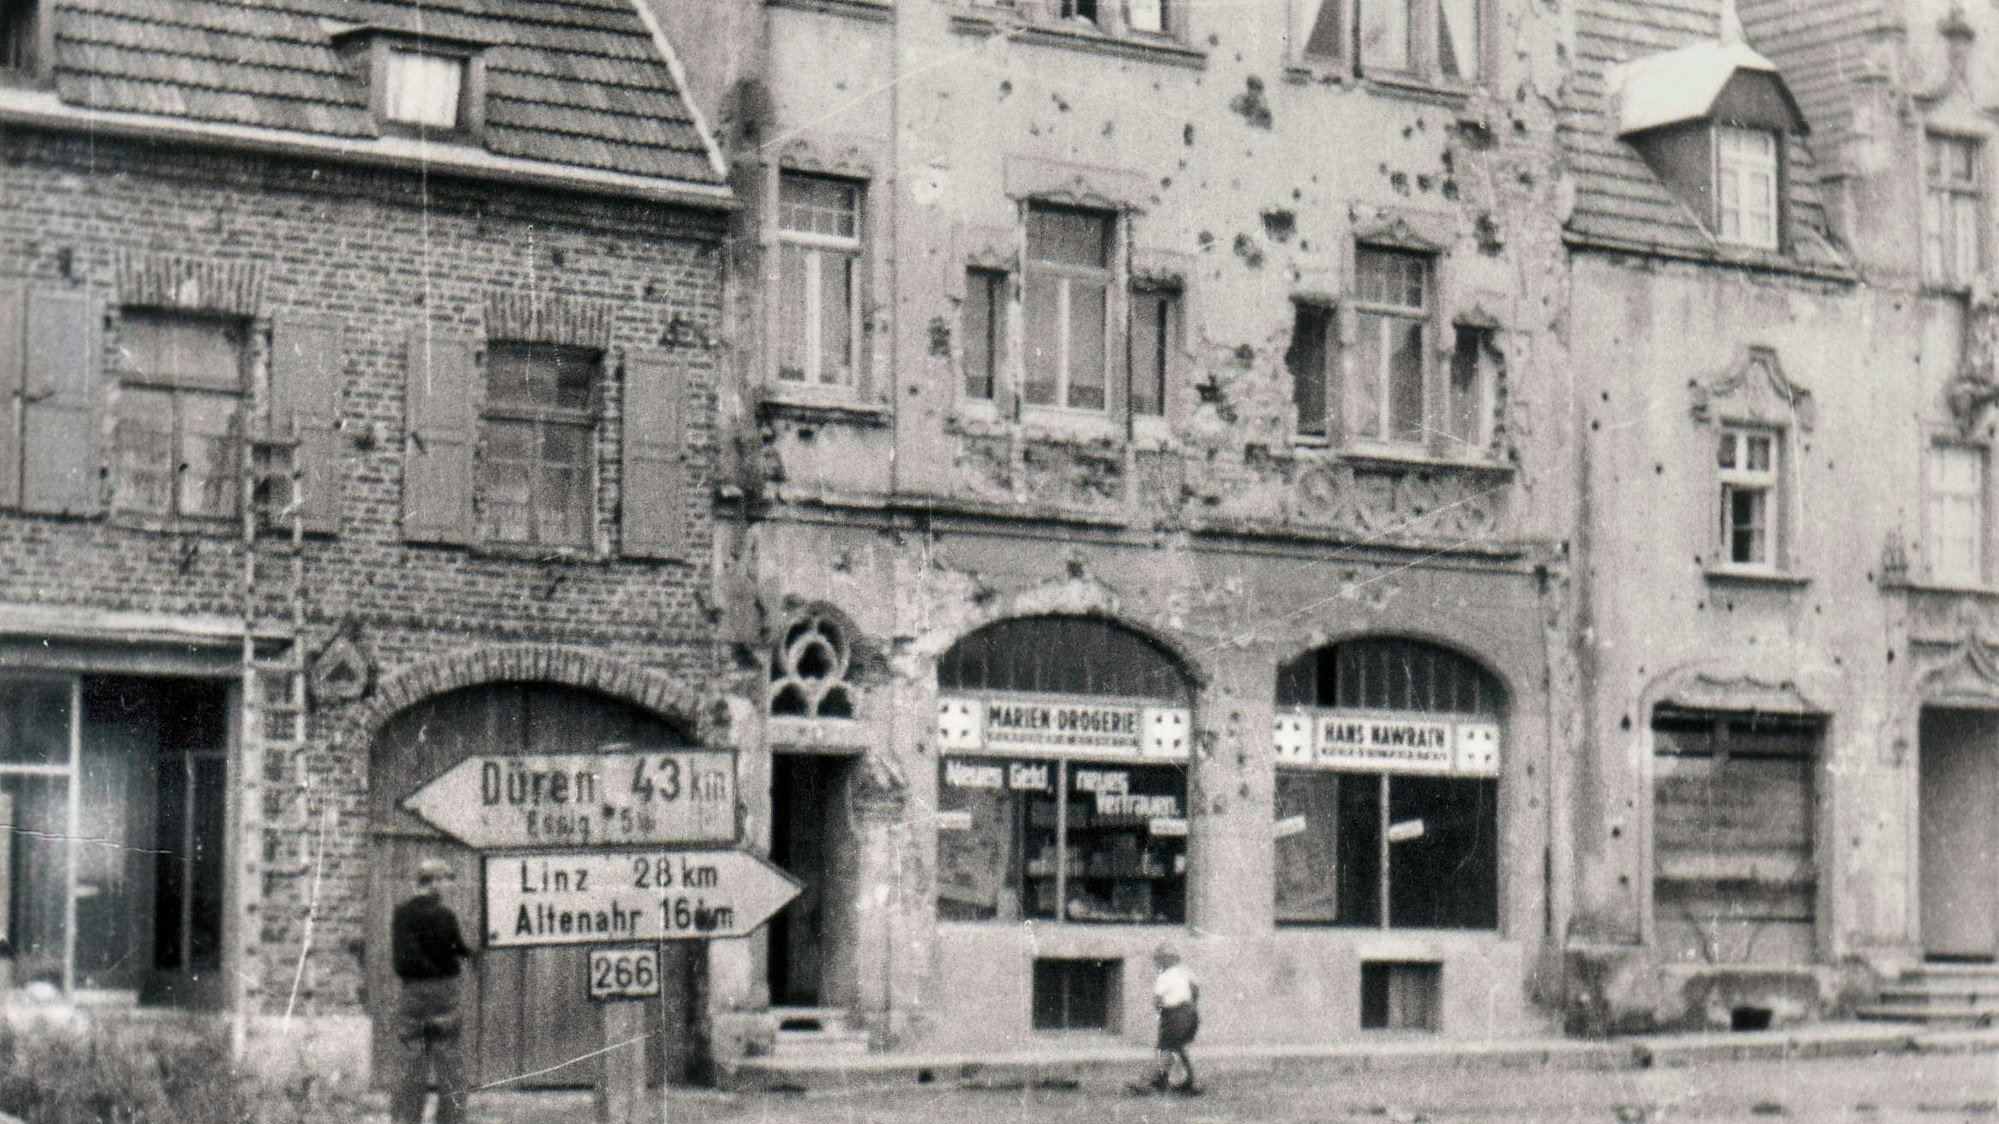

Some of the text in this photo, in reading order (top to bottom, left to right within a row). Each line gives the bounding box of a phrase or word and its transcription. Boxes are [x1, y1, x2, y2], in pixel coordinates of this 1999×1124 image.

[990, 706, 1135, 734] MARIEN DROGERIE
[1325, 723, 1364, 744] HANS
[481, 757, 727, 806] Düren 43 km
[521, 854, 718, 894] Linz 28 km
[515, 900, 643, 938] Altenahr
[659, 895, 689, 932] 16
[594, 955, 655, 990] 266
